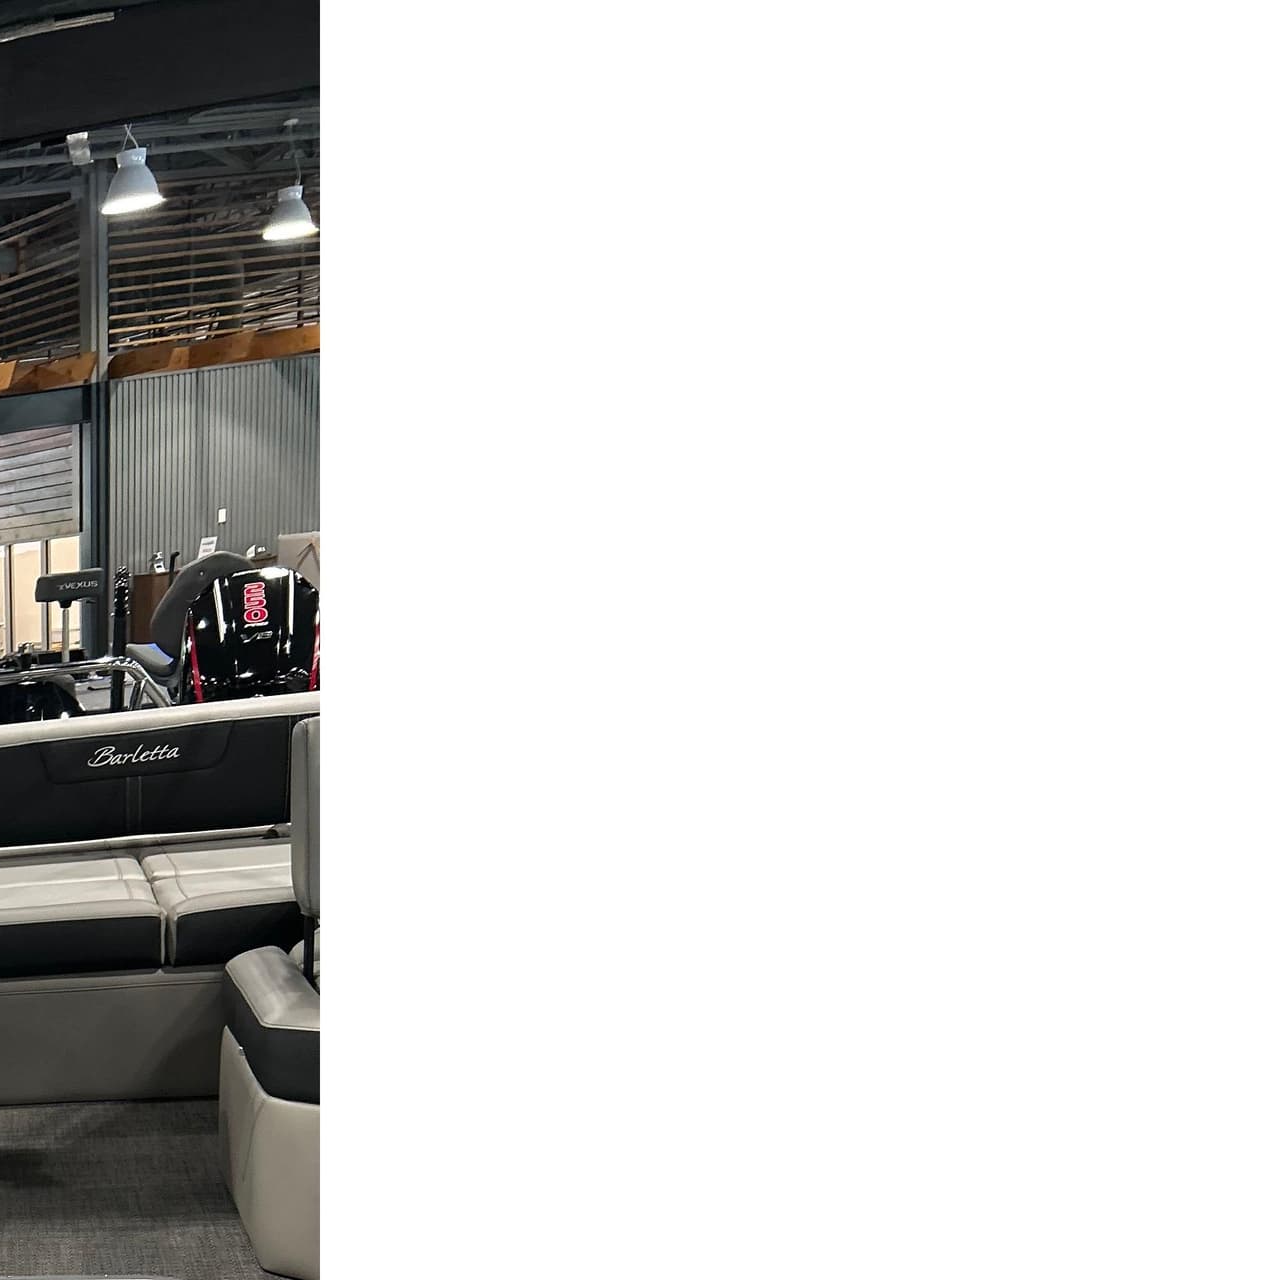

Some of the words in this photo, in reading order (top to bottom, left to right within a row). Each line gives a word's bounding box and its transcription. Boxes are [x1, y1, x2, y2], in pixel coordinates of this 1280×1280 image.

[64, 580, 98, 590] VEXUS
[243, 581, 269, 623] 250
[87, 743, 181, 768] Barletta
